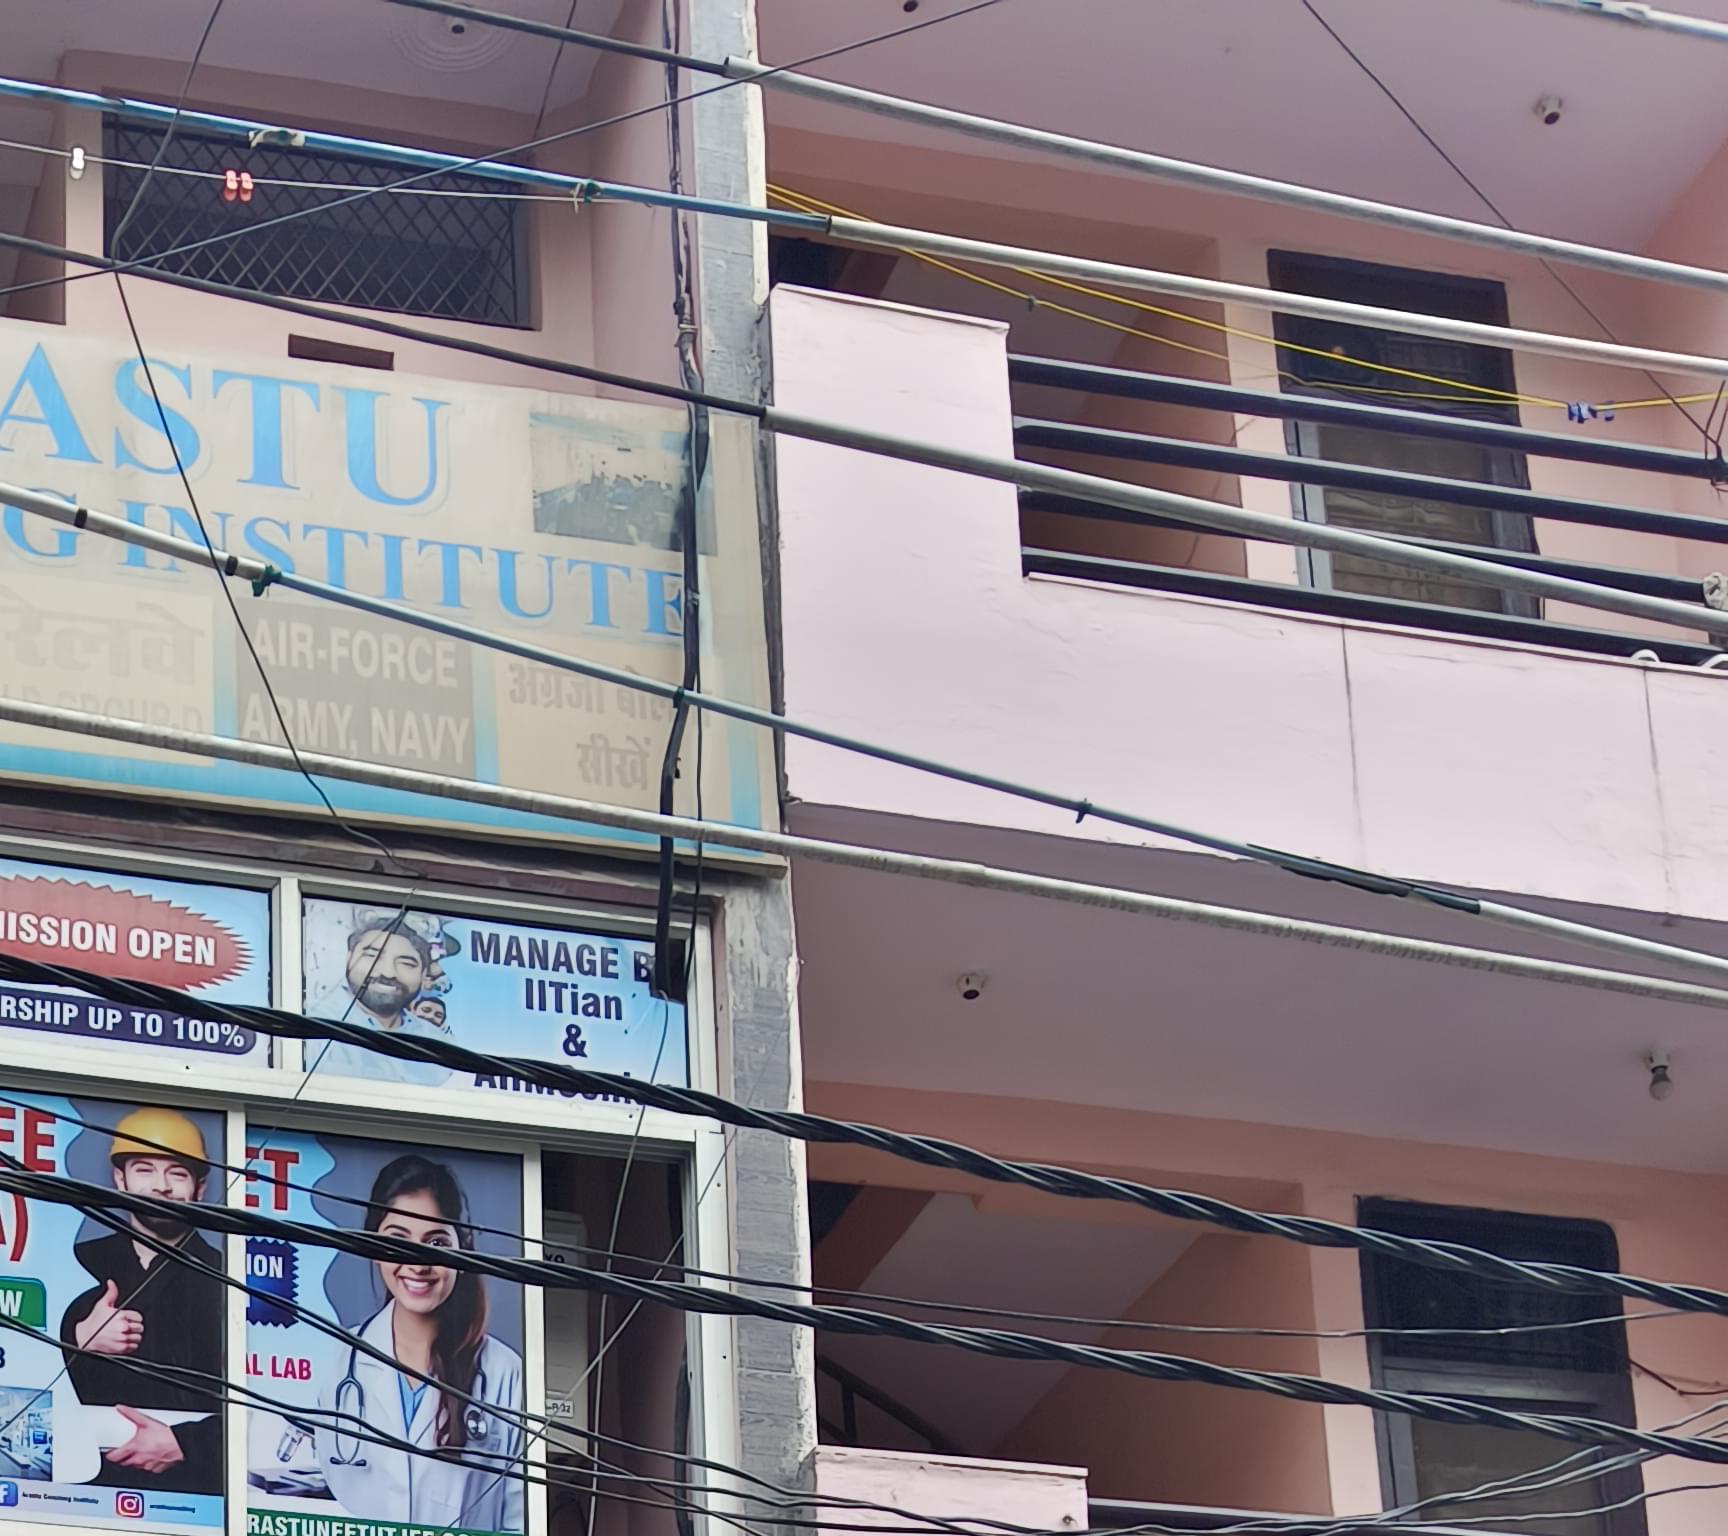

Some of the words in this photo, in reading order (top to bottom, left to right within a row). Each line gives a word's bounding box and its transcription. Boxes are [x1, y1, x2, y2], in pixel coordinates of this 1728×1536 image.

[116, 500, 686, 638] INSTITUTE
[250, 617, 459, 688] AIR-FORCE
[240, 692, 357, 761] ARMY,
[368, 706, 471, 765] NAVY
[128, 926, 216, 967] OPEN
[470, 930, 620, 980] MANAGE
[525, 977, 623, 1021] IITian
[88, 1005, 122, 1033] UP
[131, 1011, 163, 1037] TO
[172, 1017, 245, 1048] 100%
[562, 1023, 588, 1058] &
[271, 1357, 312, 1381] LAB
